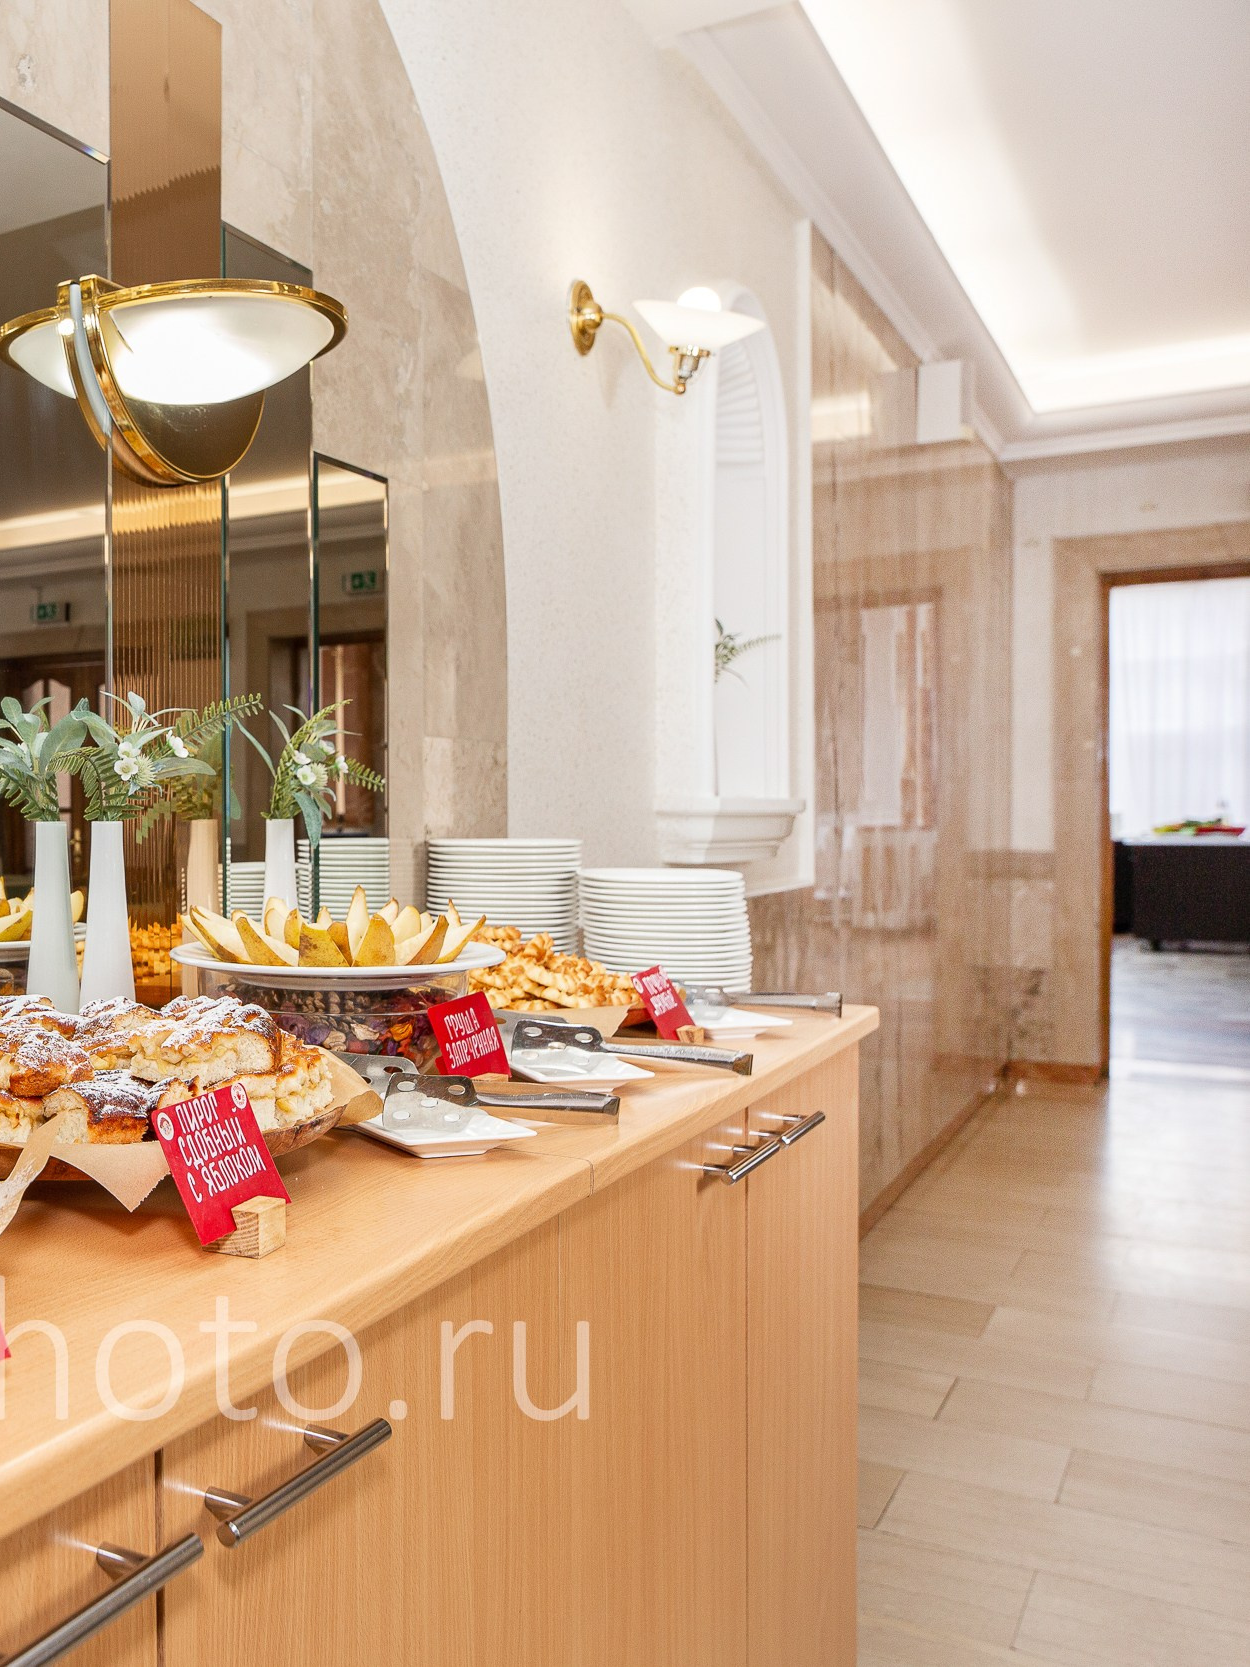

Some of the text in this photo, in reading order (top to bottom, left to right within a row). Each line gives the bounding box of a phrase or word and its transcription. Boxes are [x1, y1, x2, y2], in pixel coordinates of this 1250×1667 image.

[443, 1007, 480, 1040] ГРУША
[445, 1026, 500, 1069] ЗАПЕЧЕННАЯ
[175, 1092, 218, 1134] ПИРОГ
[177, 1107, 246, 1170] СДОБНЫЙ
[186, 1144, 266, 1203] С ЯБЛОКОМ
